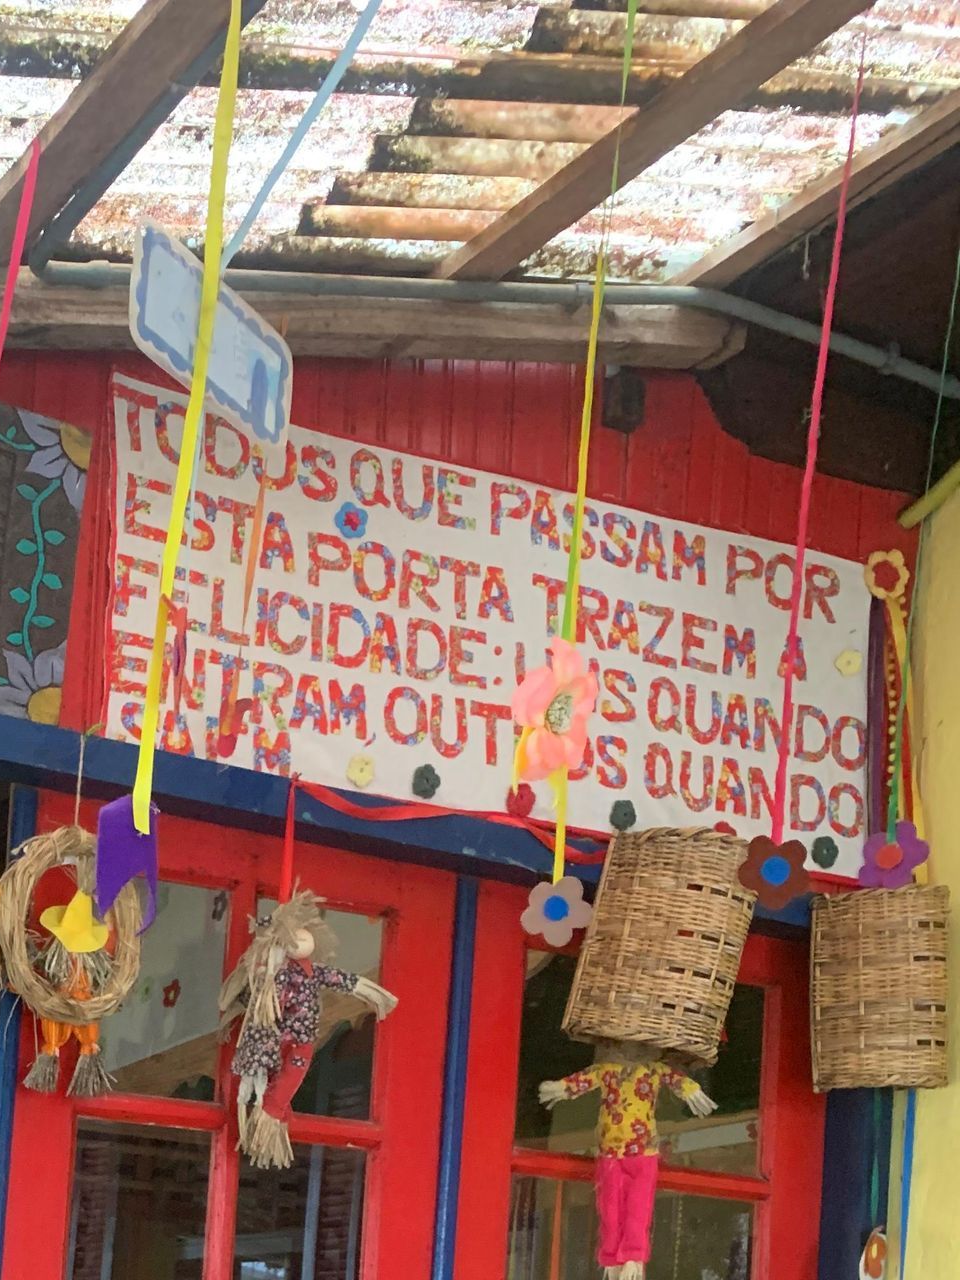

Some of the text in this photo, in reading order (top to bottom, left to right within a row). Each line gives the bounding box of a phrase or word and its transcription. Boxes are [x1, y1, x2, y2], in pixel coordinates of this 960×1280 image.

[124, 472, 807, 682] ESTA PORTA TRAZEM A
[349, 447, 477, 530] QUE
[490, 482, 707, 586] PASSAM
[726, 544, 840, 624] POR
[384, 686, 628, 790] OUTS
[644, 742, 865, 838] QUANDO
[647, 676, 868, 771] QUANDO
